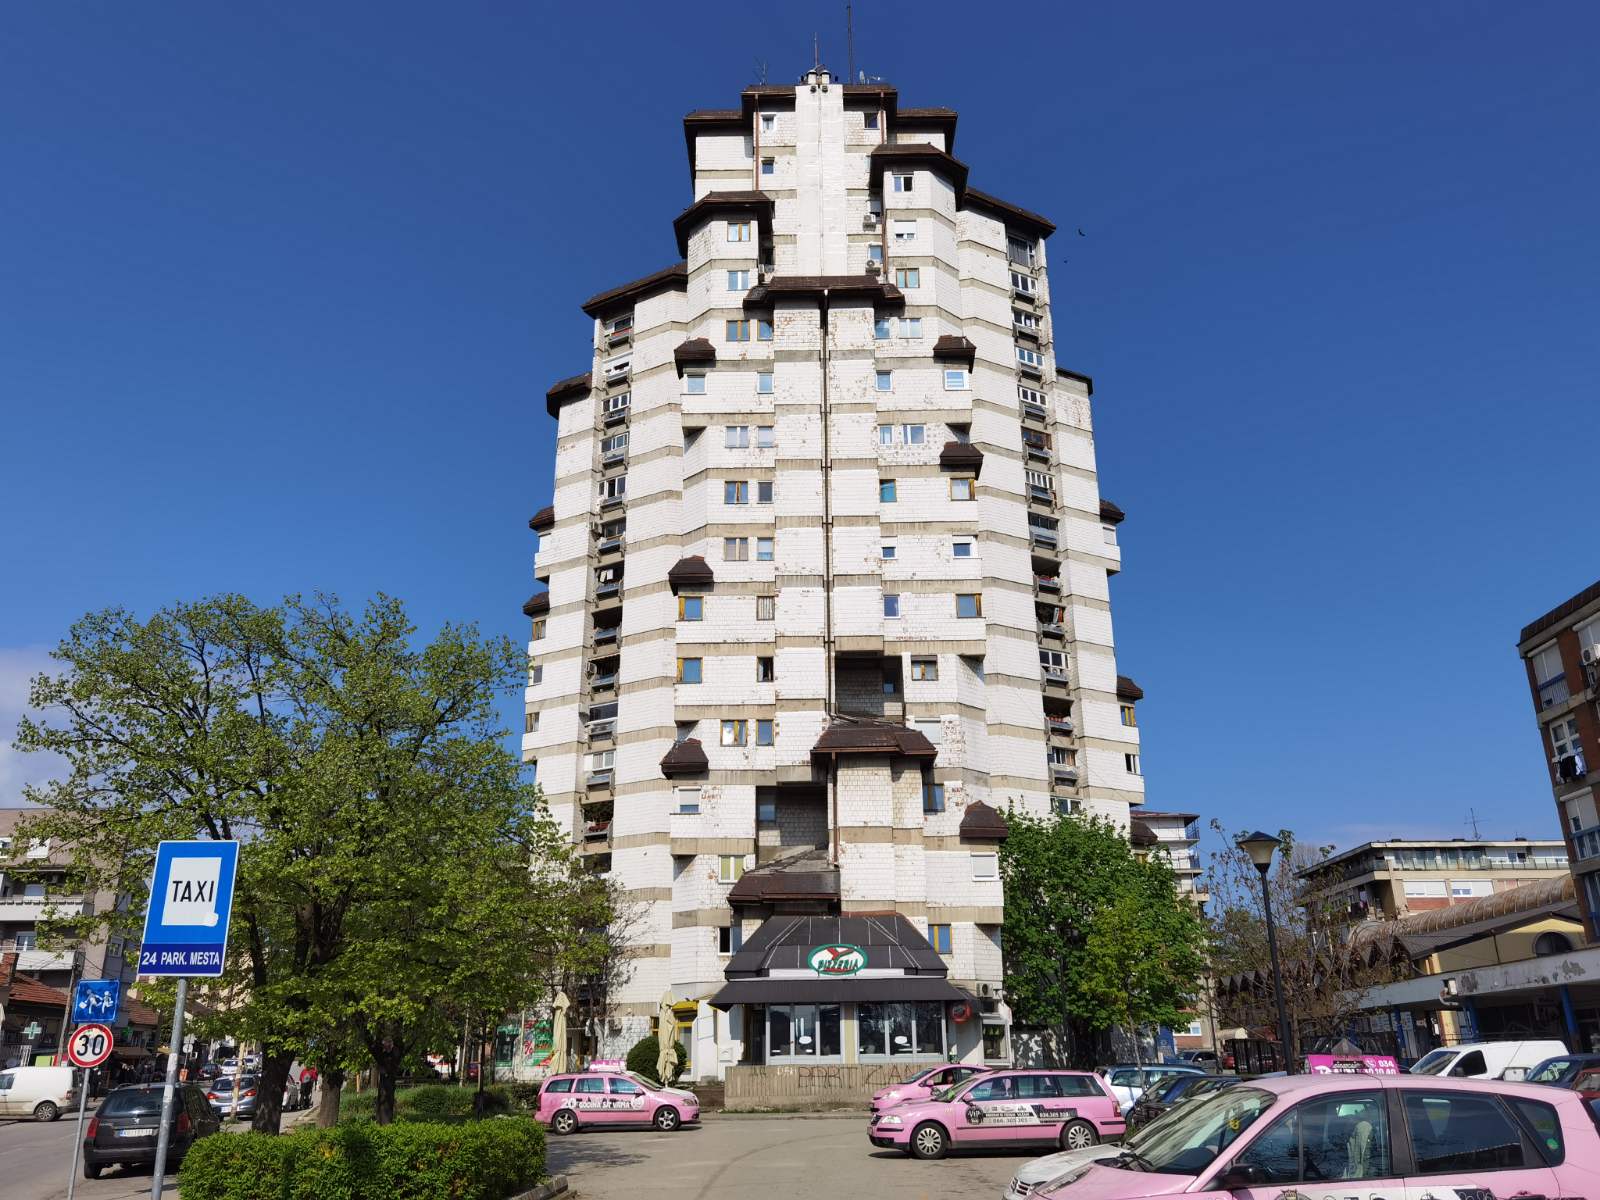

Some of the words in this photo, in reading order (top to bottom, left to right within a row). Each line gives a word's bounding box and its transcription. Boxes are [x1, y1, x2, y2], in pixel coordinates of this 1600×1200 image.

[172, 880, 215, 902] TAXI
[141, 951, 157, 965] 24
[160, 951, 187, 965] PARK.
[190, 951, 220, 965] MESTA
[817, 959, 859, 970] PIZZERIA
[76, 1034, 105, 1057] 30
